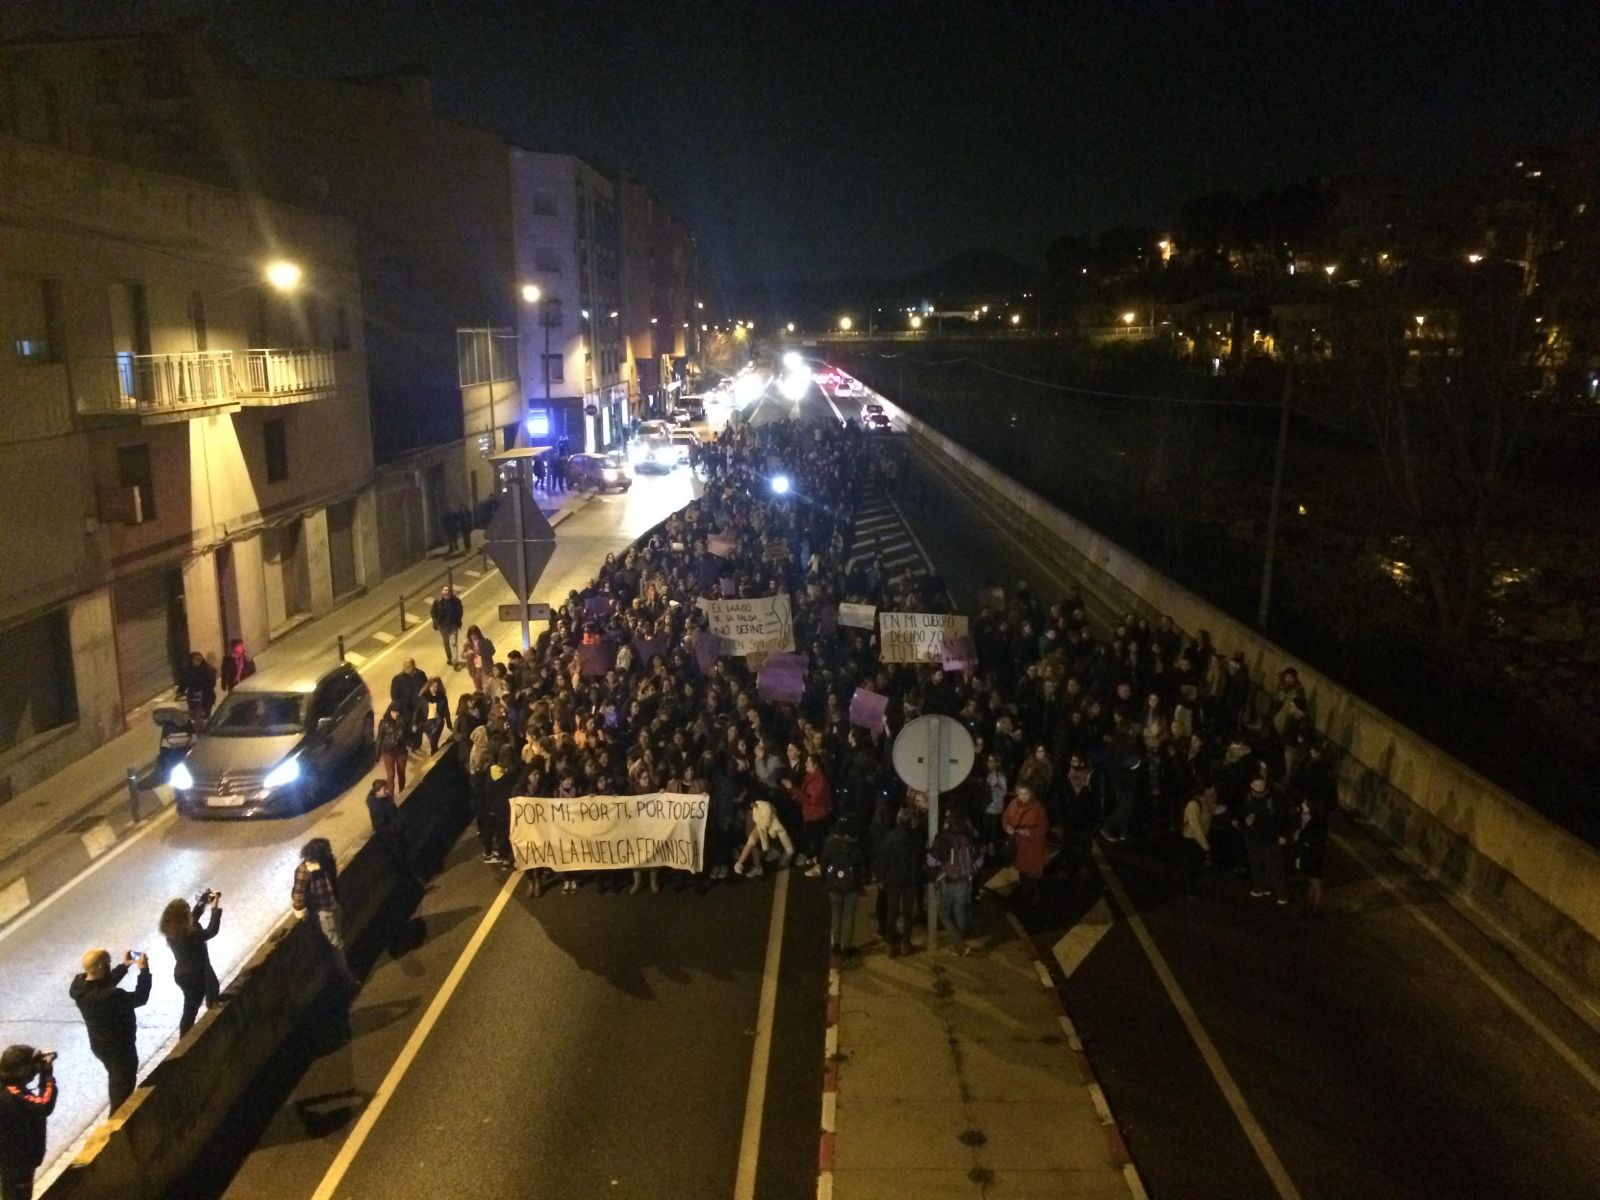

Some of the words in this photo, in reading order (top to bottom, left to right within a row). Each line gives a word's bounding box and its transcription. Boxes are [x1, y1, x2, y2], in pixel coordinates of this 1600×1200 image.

[726, 604, 752, 613] LARGO
[883, 614, 900, 630] EN
[904, 614, 917, 628] MI
[922, 615, 954, 628] CUERPO
[719, 624, 730, 635] NO
[736, 624, 763, 635] DEFINE
[890, 630, 925, 643] DECIDO
[514, 802, 547, 827] POR
[580, 802, 610, 822] POR
[636, 800, 664, 818] POR
[667, 800, 705, 820] TODES
[514, 840, 557, 865] VIVA
[559, 838, 581, 865] LA
[580, 838, 636, 865] HUELGA
[633, 837, 700, 868] FEMINISTA
